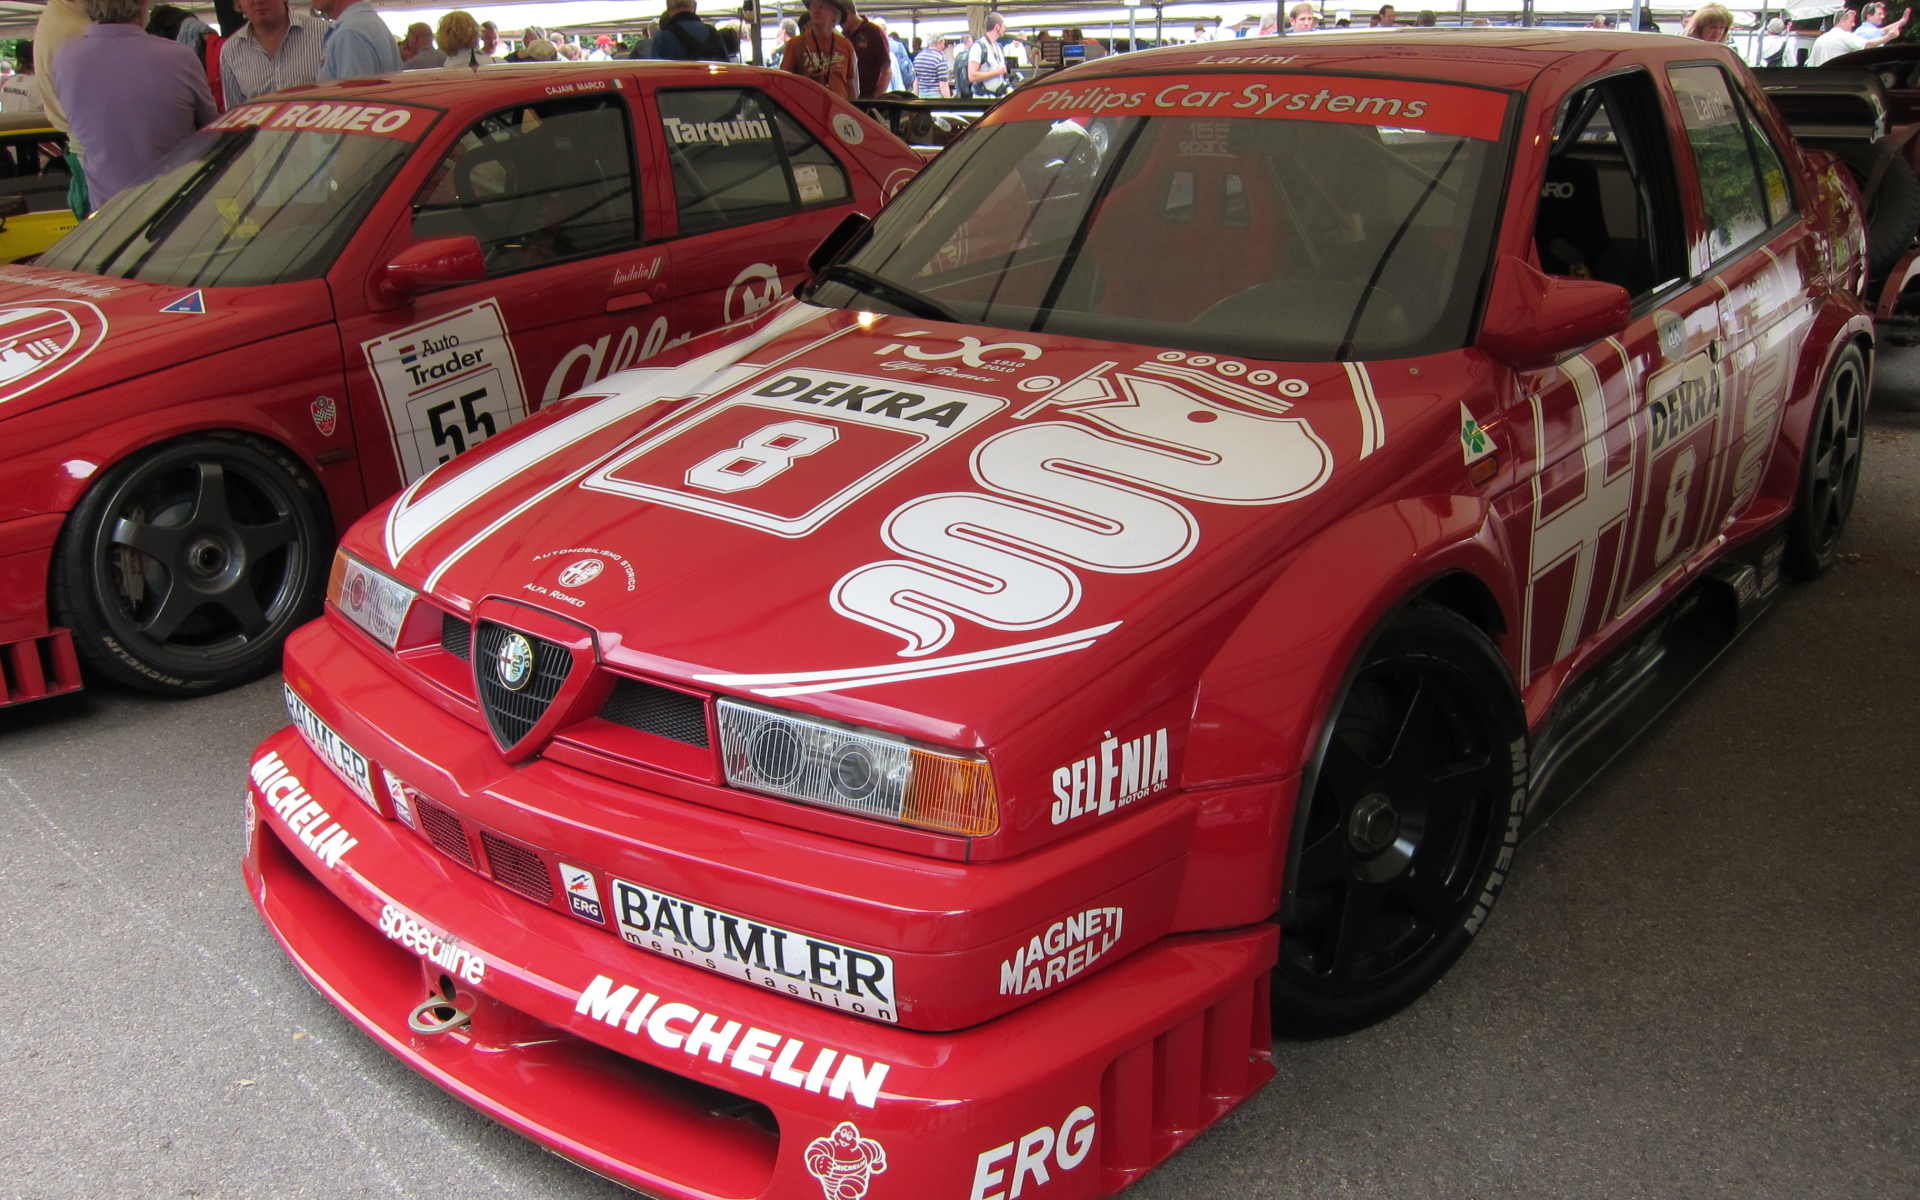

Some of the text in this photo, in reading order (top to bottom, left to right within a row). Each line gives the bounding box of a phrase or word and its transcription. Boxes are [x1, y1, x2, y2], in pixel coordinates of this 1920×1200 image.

[1196, 53, 1299, 66] Larini
[545, 80, 606, 95] CAJANI MARCO
[1026, 83, 1430, 119] Philips Car Systems
[1690, 91, 1727, 122] Larini
[271, 104, 412, 134] ROMEO
[662, 113, 773, 147] Tarquini
[843, 122, 857, 138] 47
[421, 334, 460, 358] Auto
[991, 359, 1026, 369] 1910
[405, 348, 485, 387] Trader
[981, 364, 1016, 374] 2010
[751, 375, 969, 429] DEKRA
[1650, 368, 1722, 452] DEKRA
[426, 387, 498, 466] 55
[684, 419, 841, 494] 8
[1654, 444, 1697, 568] 8
[532, 547, 636, 592] AUTOMOBILISMO STORICO
[523, 582, 587, 608] ALFA ROMEO
[102, 635, 184, 687] MICHELIN
[250, 750, 359, 869] MICHELIN
[1118, 780, 1168, 808] MOTOR OIL
[1463, 734, 1528, 937] MICHELIN
[572, 897, 600, 917] ERG
[379, 903, 485, 985] speedline
[616, 882, 890, 1006] BÄUMLER
[744, 967, 892, 1021] fashion
[574, 973, 891, 1110] MICHELIN
[969, 1105, 1097, 1200] ERG
